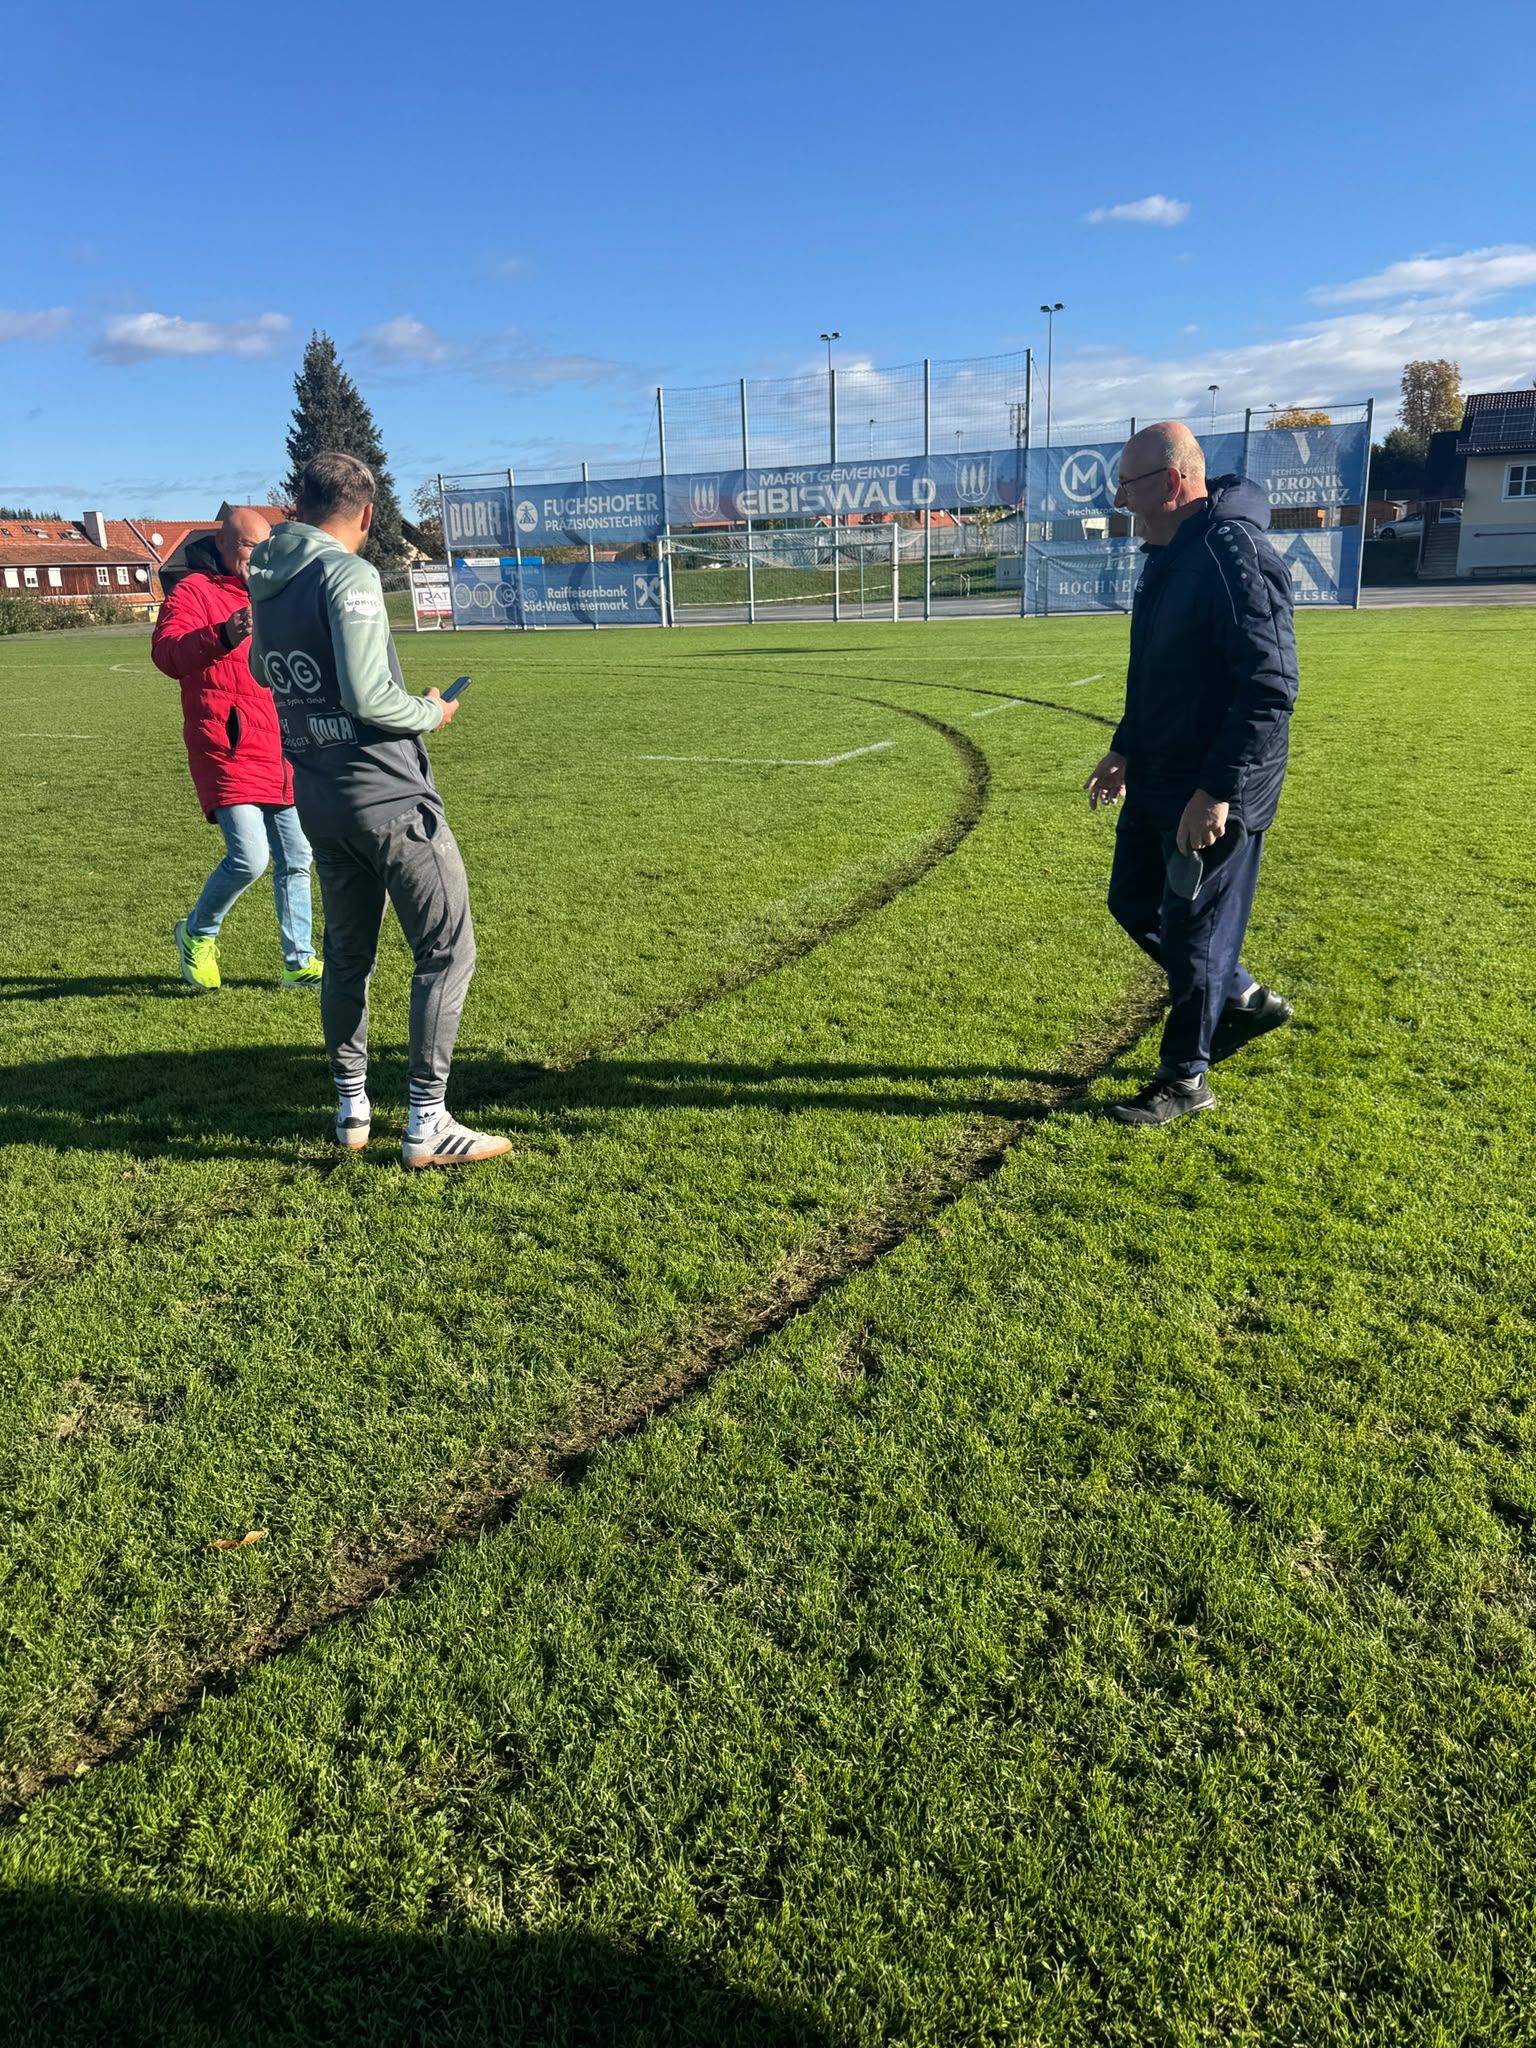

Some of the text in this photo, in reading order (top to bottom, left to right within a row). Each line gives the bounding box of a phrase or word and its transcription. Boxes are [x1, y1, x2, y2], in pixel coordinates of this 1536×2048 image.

[759, 464, 911, 486] MARKTGEMEINDE
[544, 493, 660, 517] FUCHSHOFER
[736, 478, 937, 516] EIBISWALD
[547, 585, 628, 599] Raiffeisenbank
[523, 598, 629, 613] Süd-Weststeiermark
